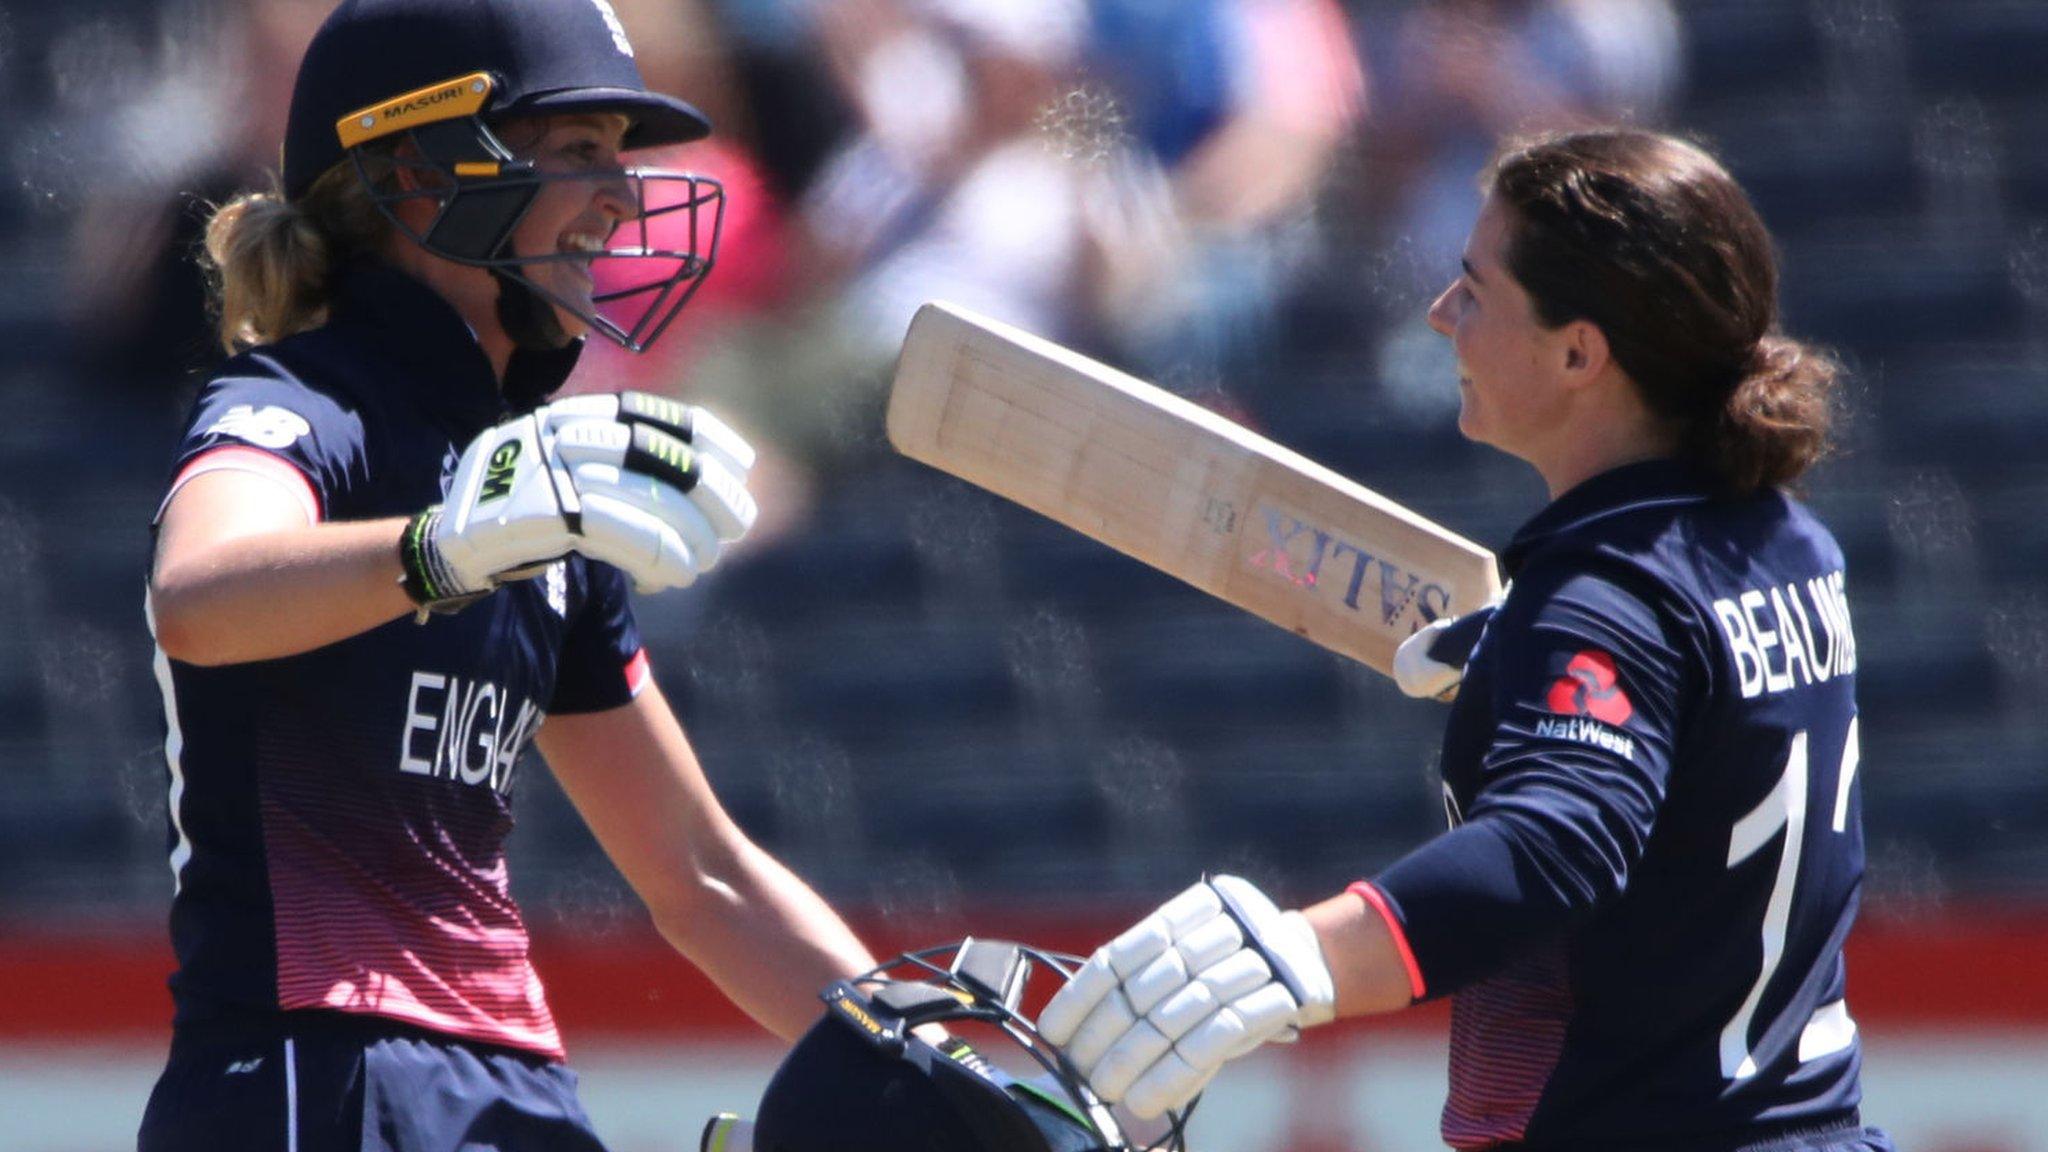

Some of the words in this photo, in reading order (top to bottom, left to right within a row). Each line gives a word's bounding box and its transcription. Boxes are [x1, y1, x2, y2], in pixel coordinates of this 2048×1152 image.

[383, 86, 464, 118] MASURI
[479, 438, 522, 507] GM
[1713, 570, 1857, 698] BEAUM
[400, 670, 546, 796] ENGLA
[1534, 718, 1635, 761] NatWest
